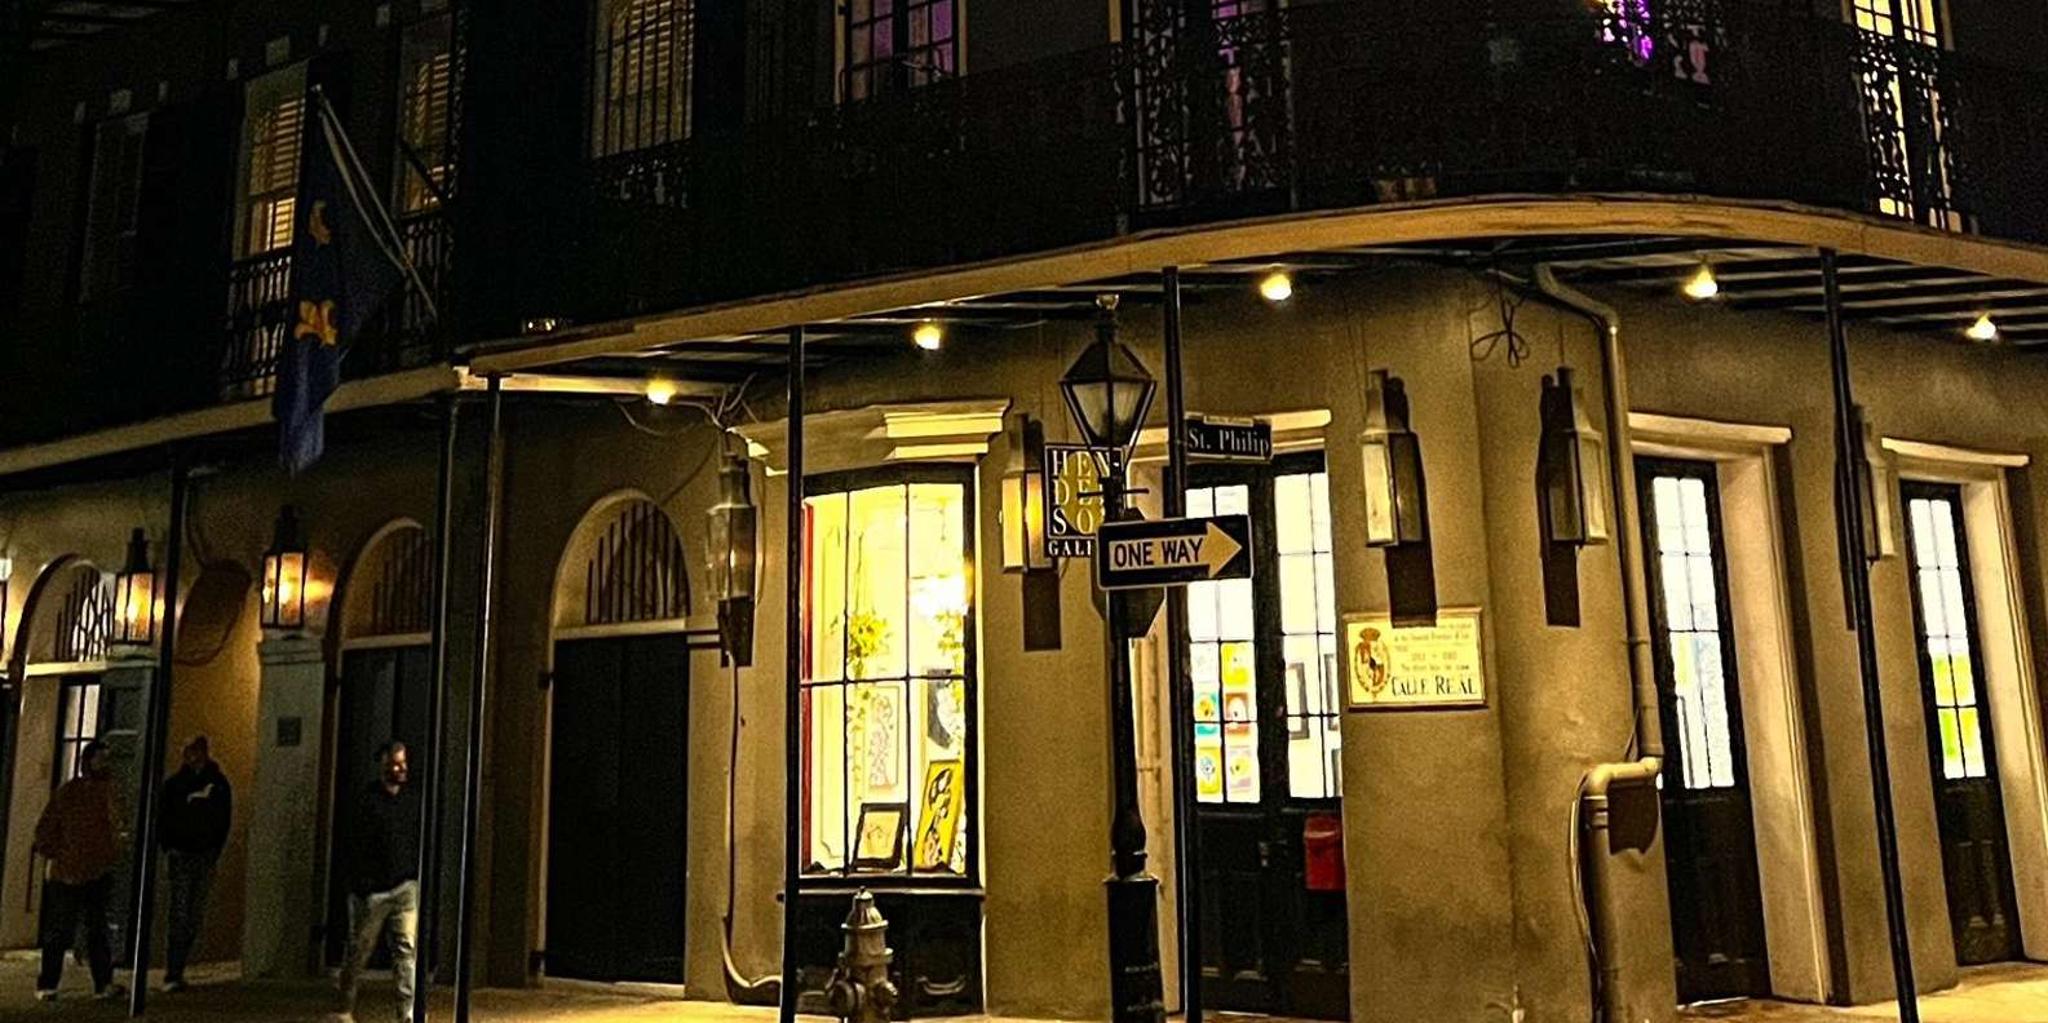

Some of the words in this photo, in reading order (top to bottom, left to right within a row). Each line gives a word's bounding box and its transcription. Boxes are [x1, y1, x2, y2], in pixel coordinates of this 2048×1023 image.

[1188, 428, 1211, 449] St.
[1219, 429, 1269, 457] Philip
[1053, 479, 1104, 506] DE
[1052, 507, 1105, 535] SO
[1114, 542, 1154, 567] ONE
[1161, 538, 1203, 564] WAY
[1435, 675, 1477, 695] REAL
